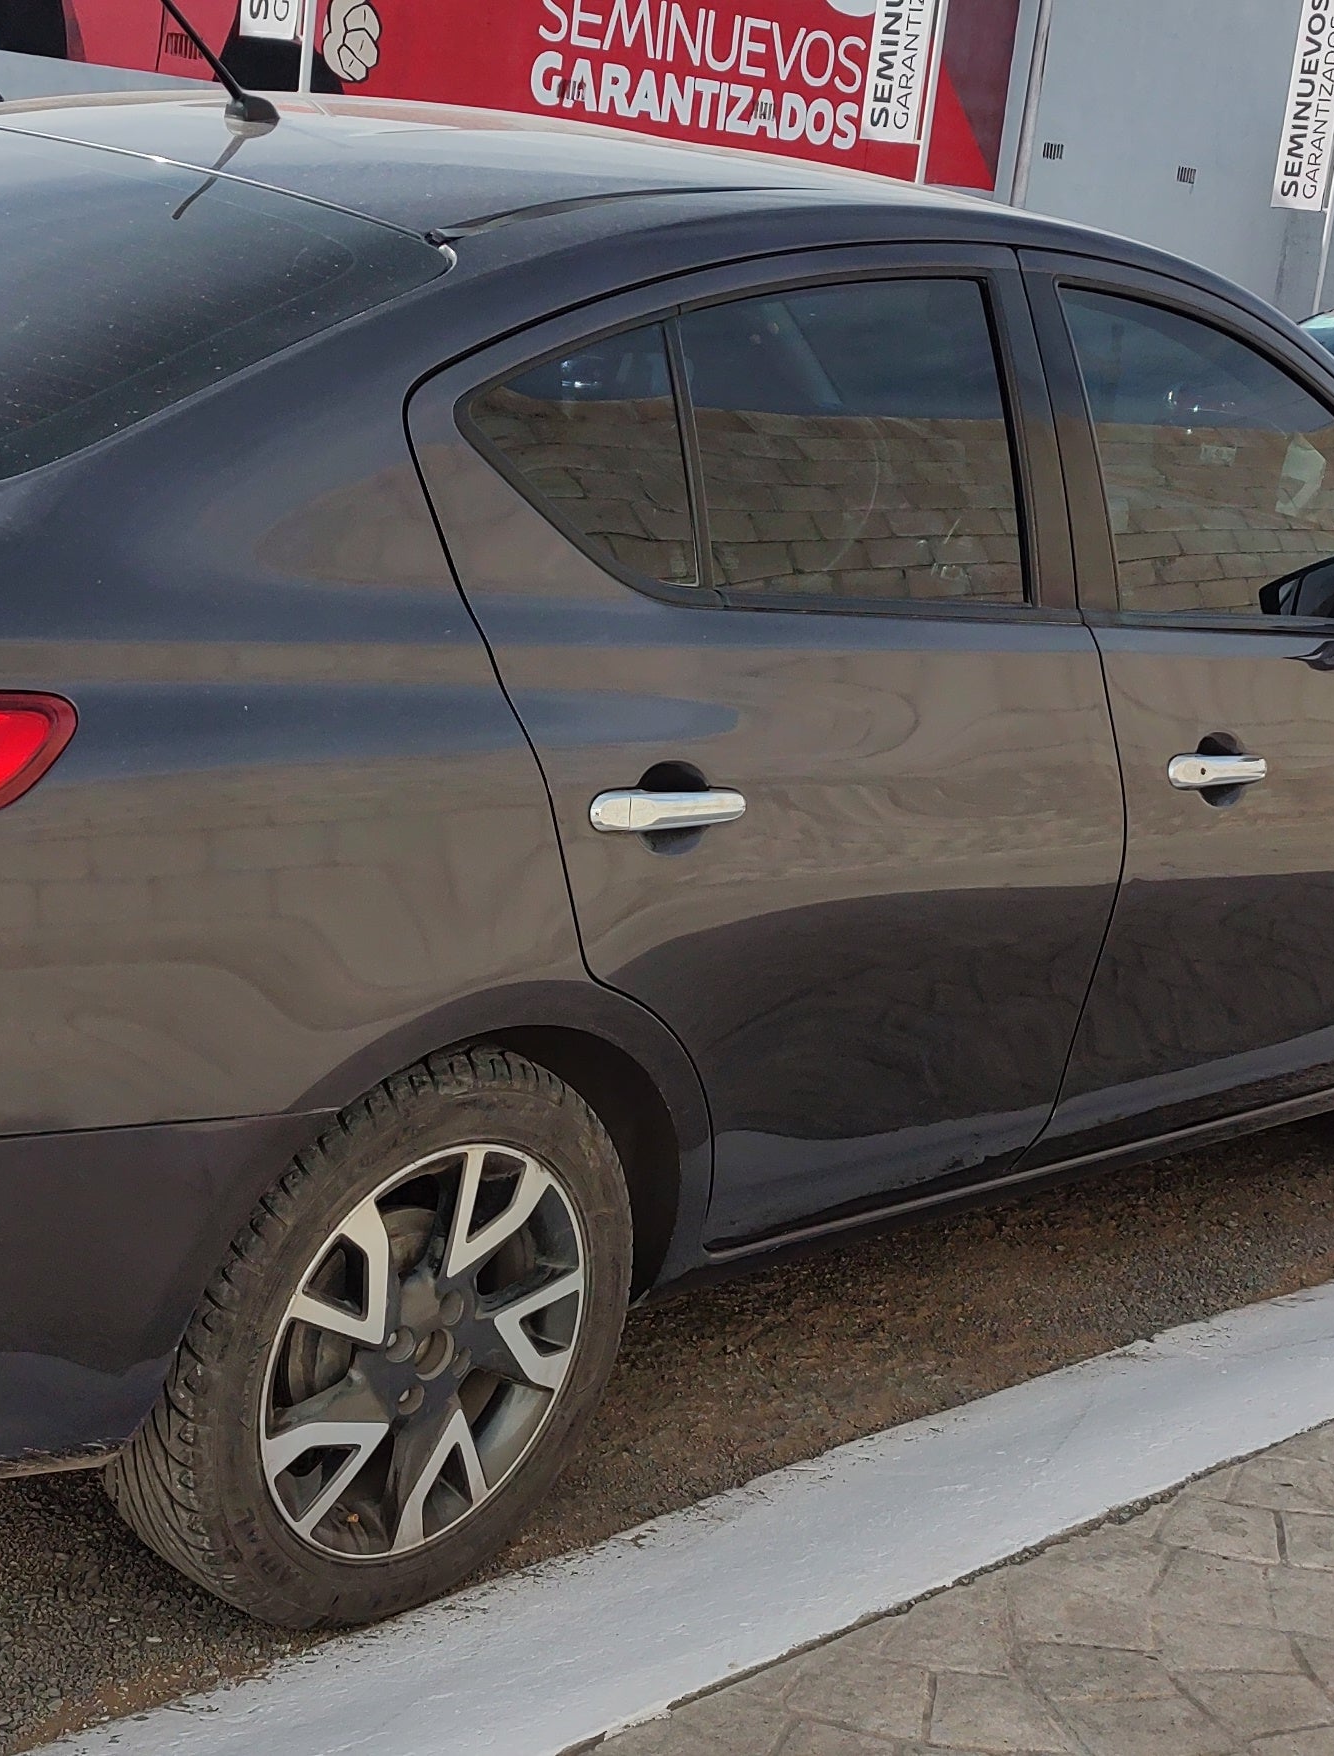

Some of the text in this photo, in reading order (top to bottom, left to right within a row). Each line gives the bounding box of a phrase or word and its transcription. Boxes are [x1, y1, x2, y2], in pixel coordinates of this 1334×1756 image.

[539, 0, 867, 94] SEMINUEVOS
[530, 50, 859, 150] GARANTIZADOS
[1281, 0, 1329, 198] SEMINUEVOS
